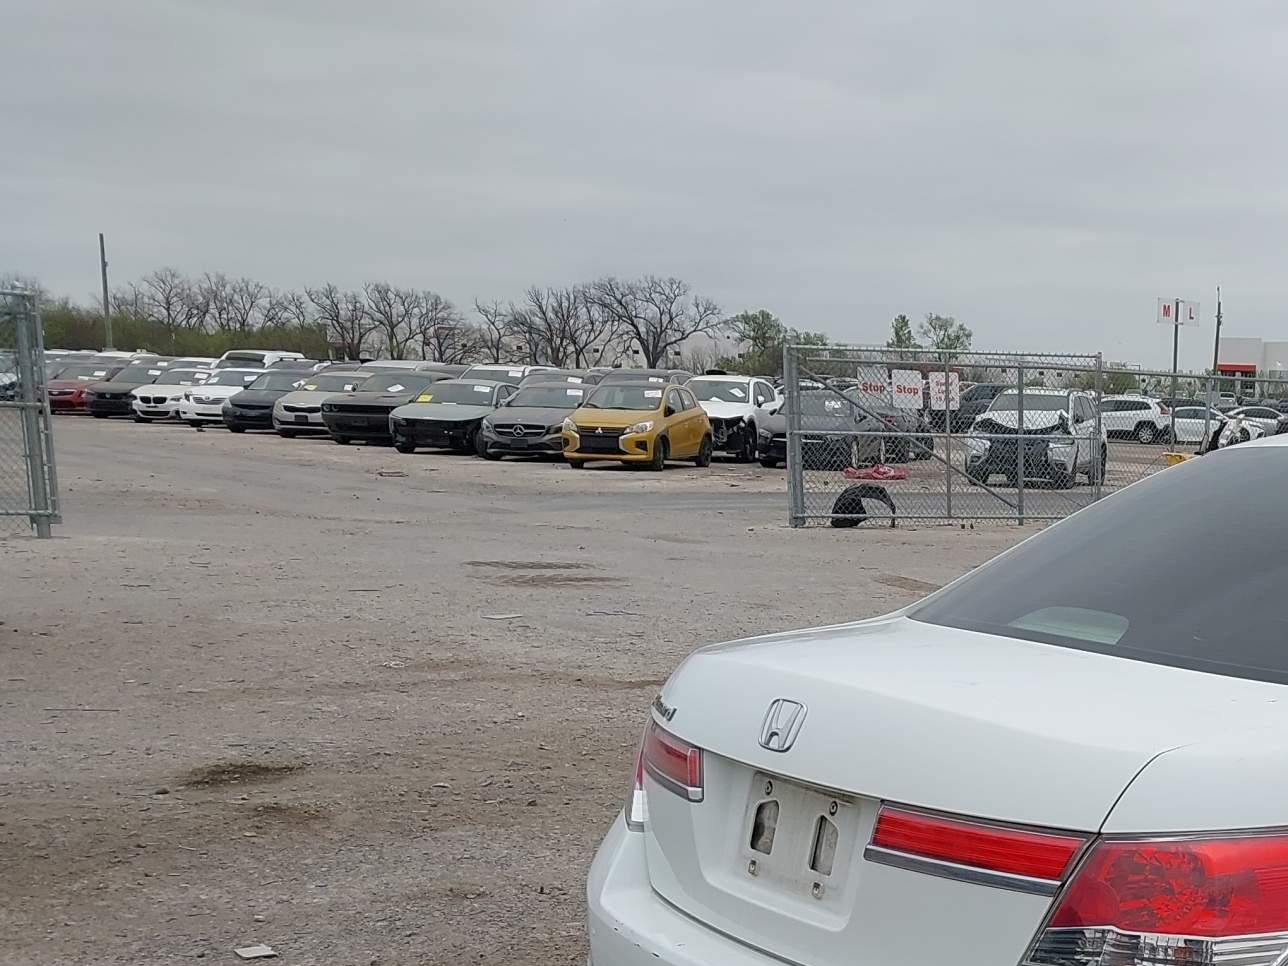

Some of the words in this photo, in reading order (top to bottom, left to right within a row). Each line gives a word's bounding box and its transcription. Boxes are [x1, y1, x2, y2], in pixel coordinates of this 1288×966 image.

[1162, 303, 1171, 318] M
[1188, 306, 1195, 320] L
[862, 382, 885, 394] Stop
[896, 384, 919, 396] Stop
